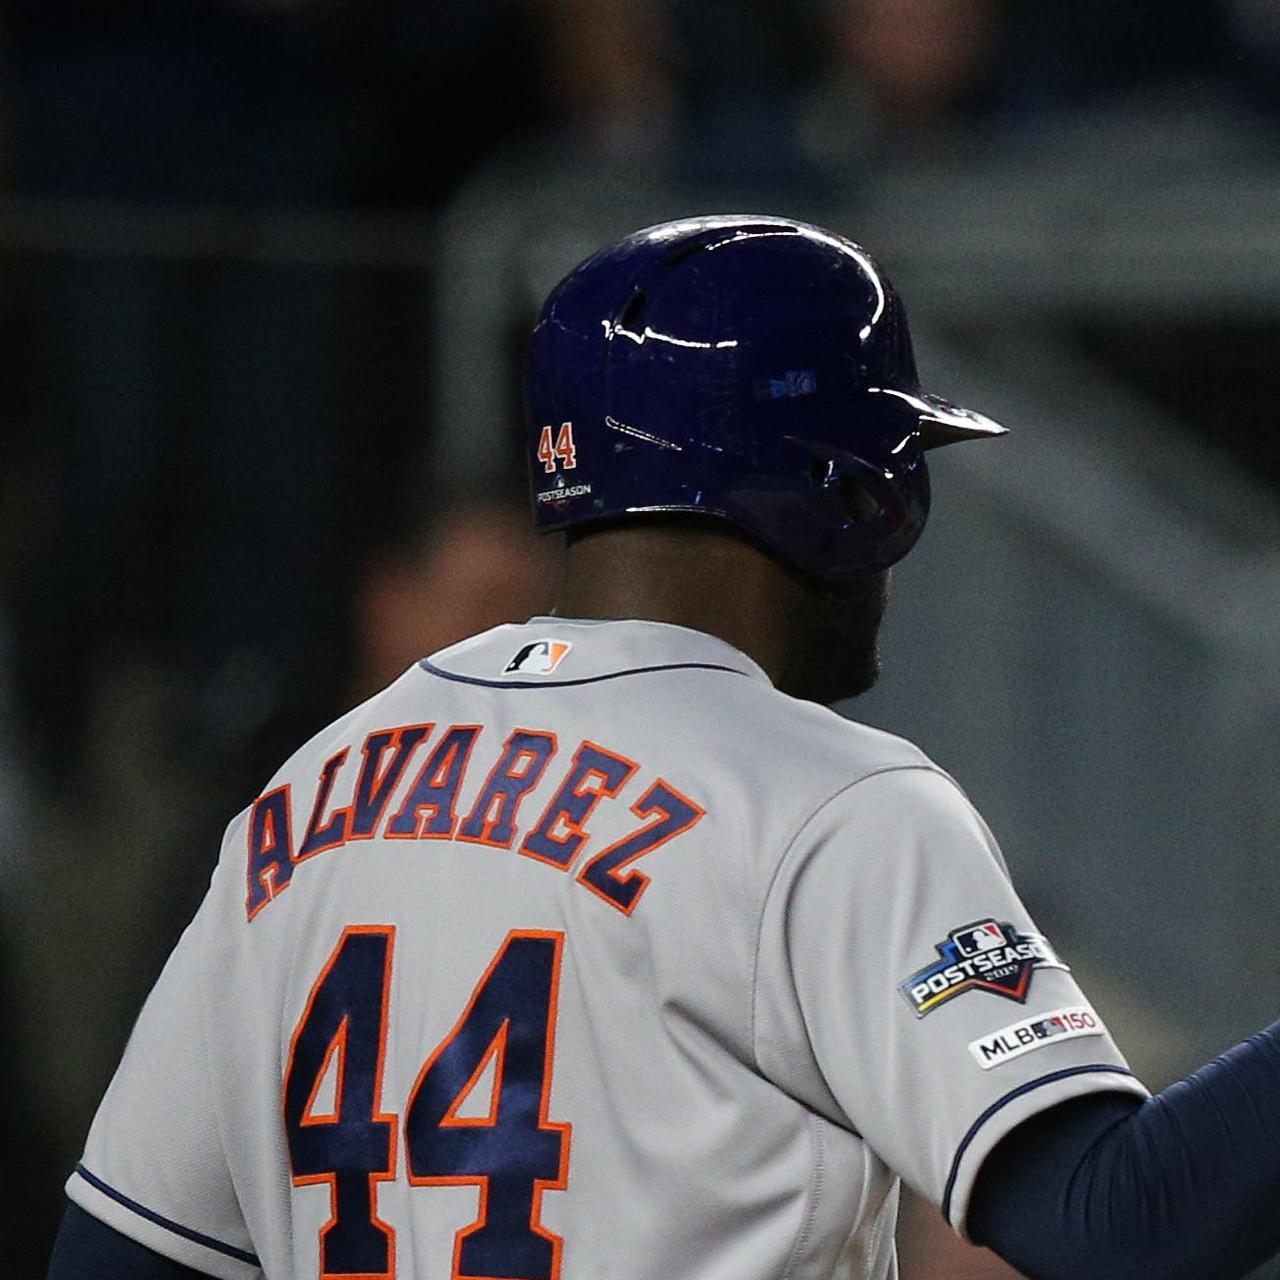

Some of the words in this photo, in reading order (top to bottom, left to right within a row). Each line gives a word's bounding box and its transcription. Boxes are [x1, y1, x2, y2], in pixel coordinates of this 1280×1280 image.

[537, 421, 577, 473] 44
[537, 484, 592, 502] POSTSEASON
[245, 722, 706, 923] ALVAREZ
[979, 1026, 1035, 1060] MLB
[1062, 1012, 1097, 1032] 150
